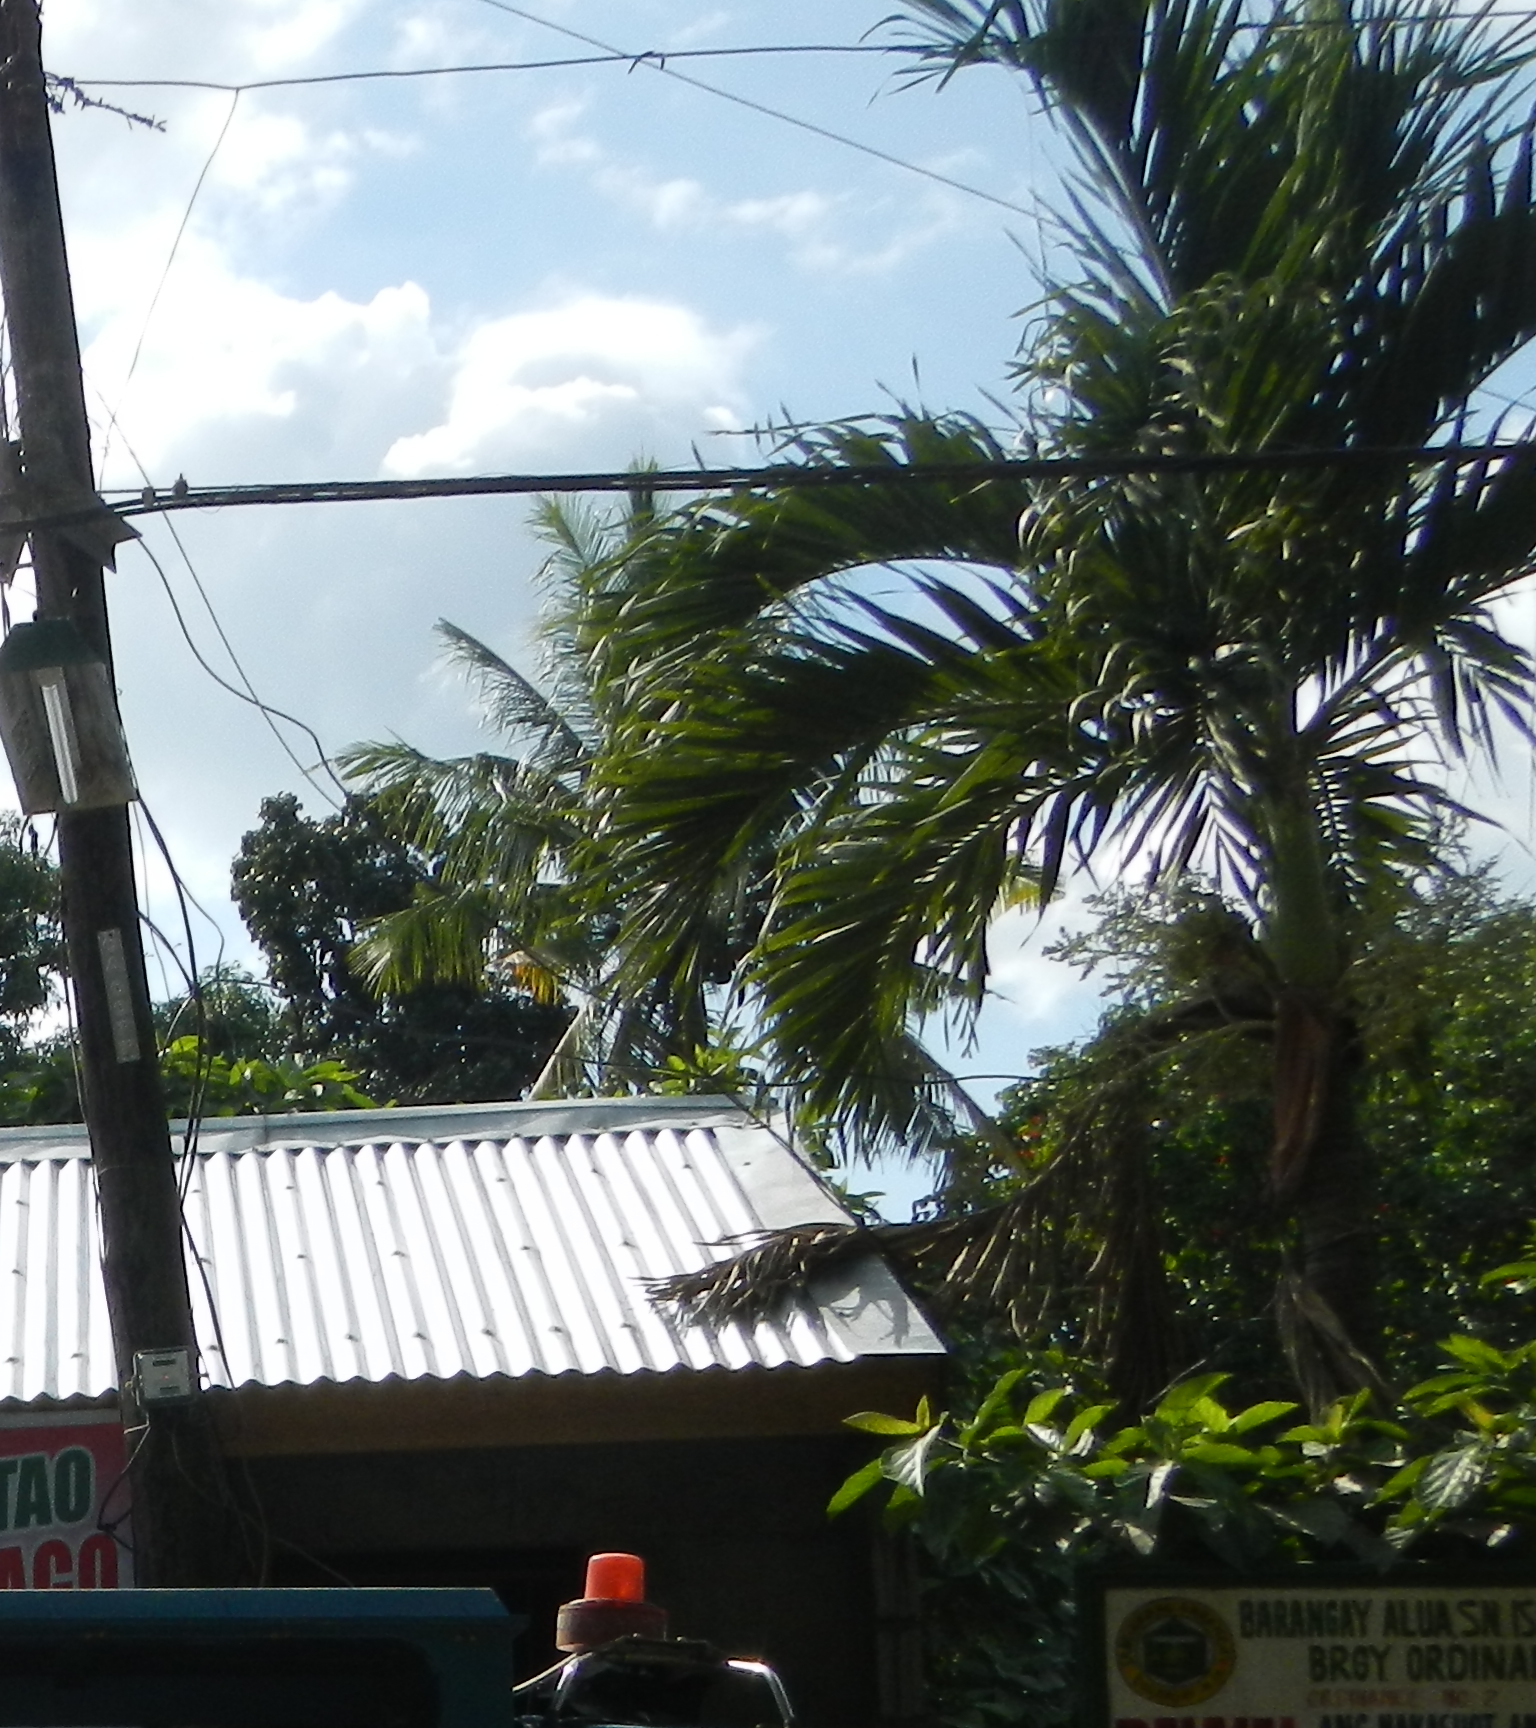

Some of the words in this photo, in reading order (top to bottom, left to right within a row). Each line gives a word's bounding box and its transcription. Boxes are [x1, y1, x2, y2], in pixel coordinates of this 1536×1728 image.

[1238, 1599, 1372, 1638] BARANGAY
[1306, 1645, 1393, 1683] BRGY
[1406, 1644, 1536, 1682] ORDINA
